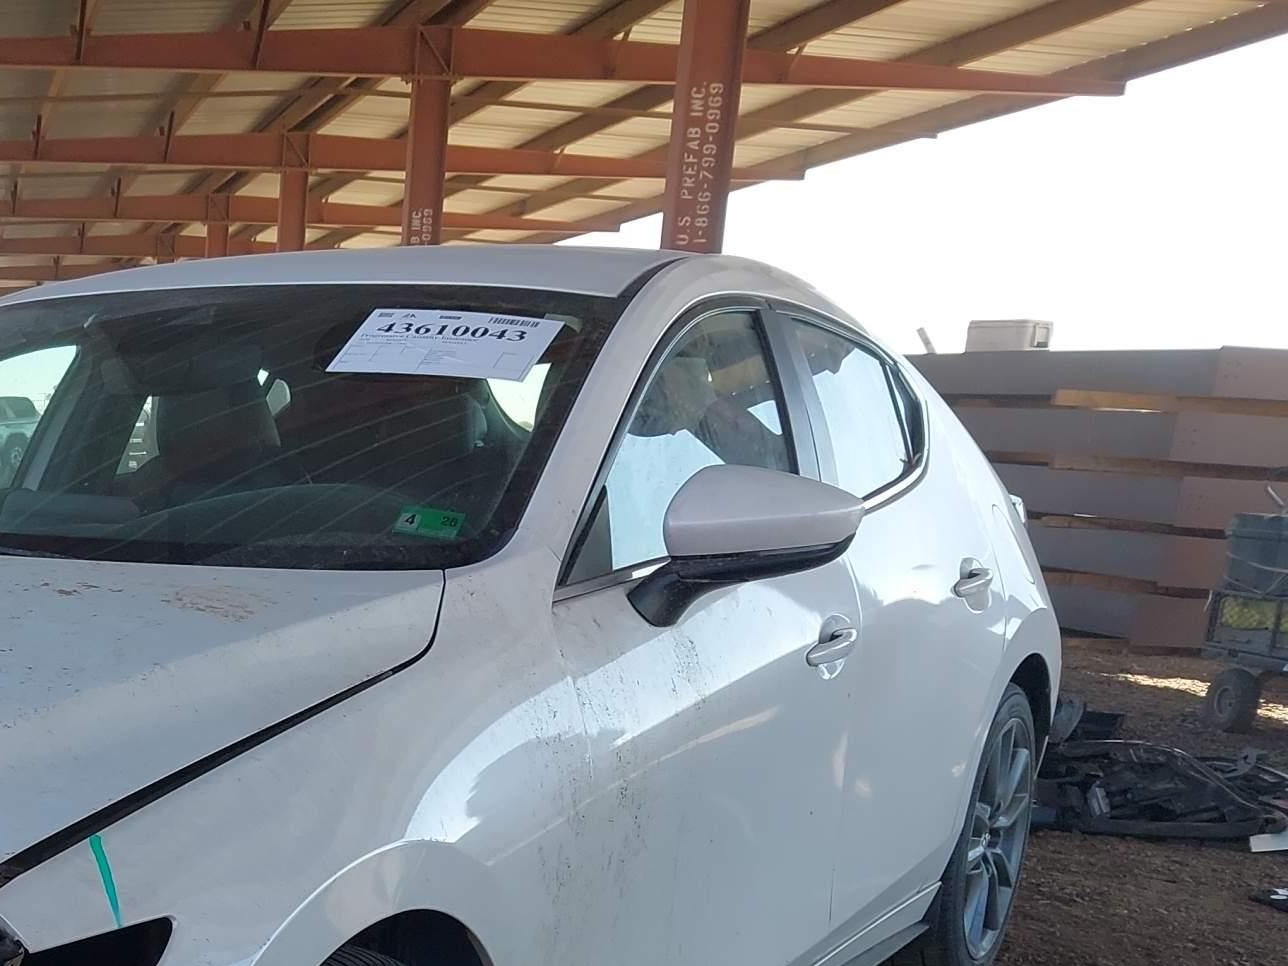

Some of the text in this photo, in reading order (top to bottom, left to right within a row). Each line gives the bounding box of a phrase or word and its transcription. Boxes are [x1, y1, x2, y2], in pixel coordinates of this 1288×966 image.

[690, 81, 707, 117] INC.
[680, 127, 702, 200] PREFAB
[376, 322, 528, 343] 43610043
